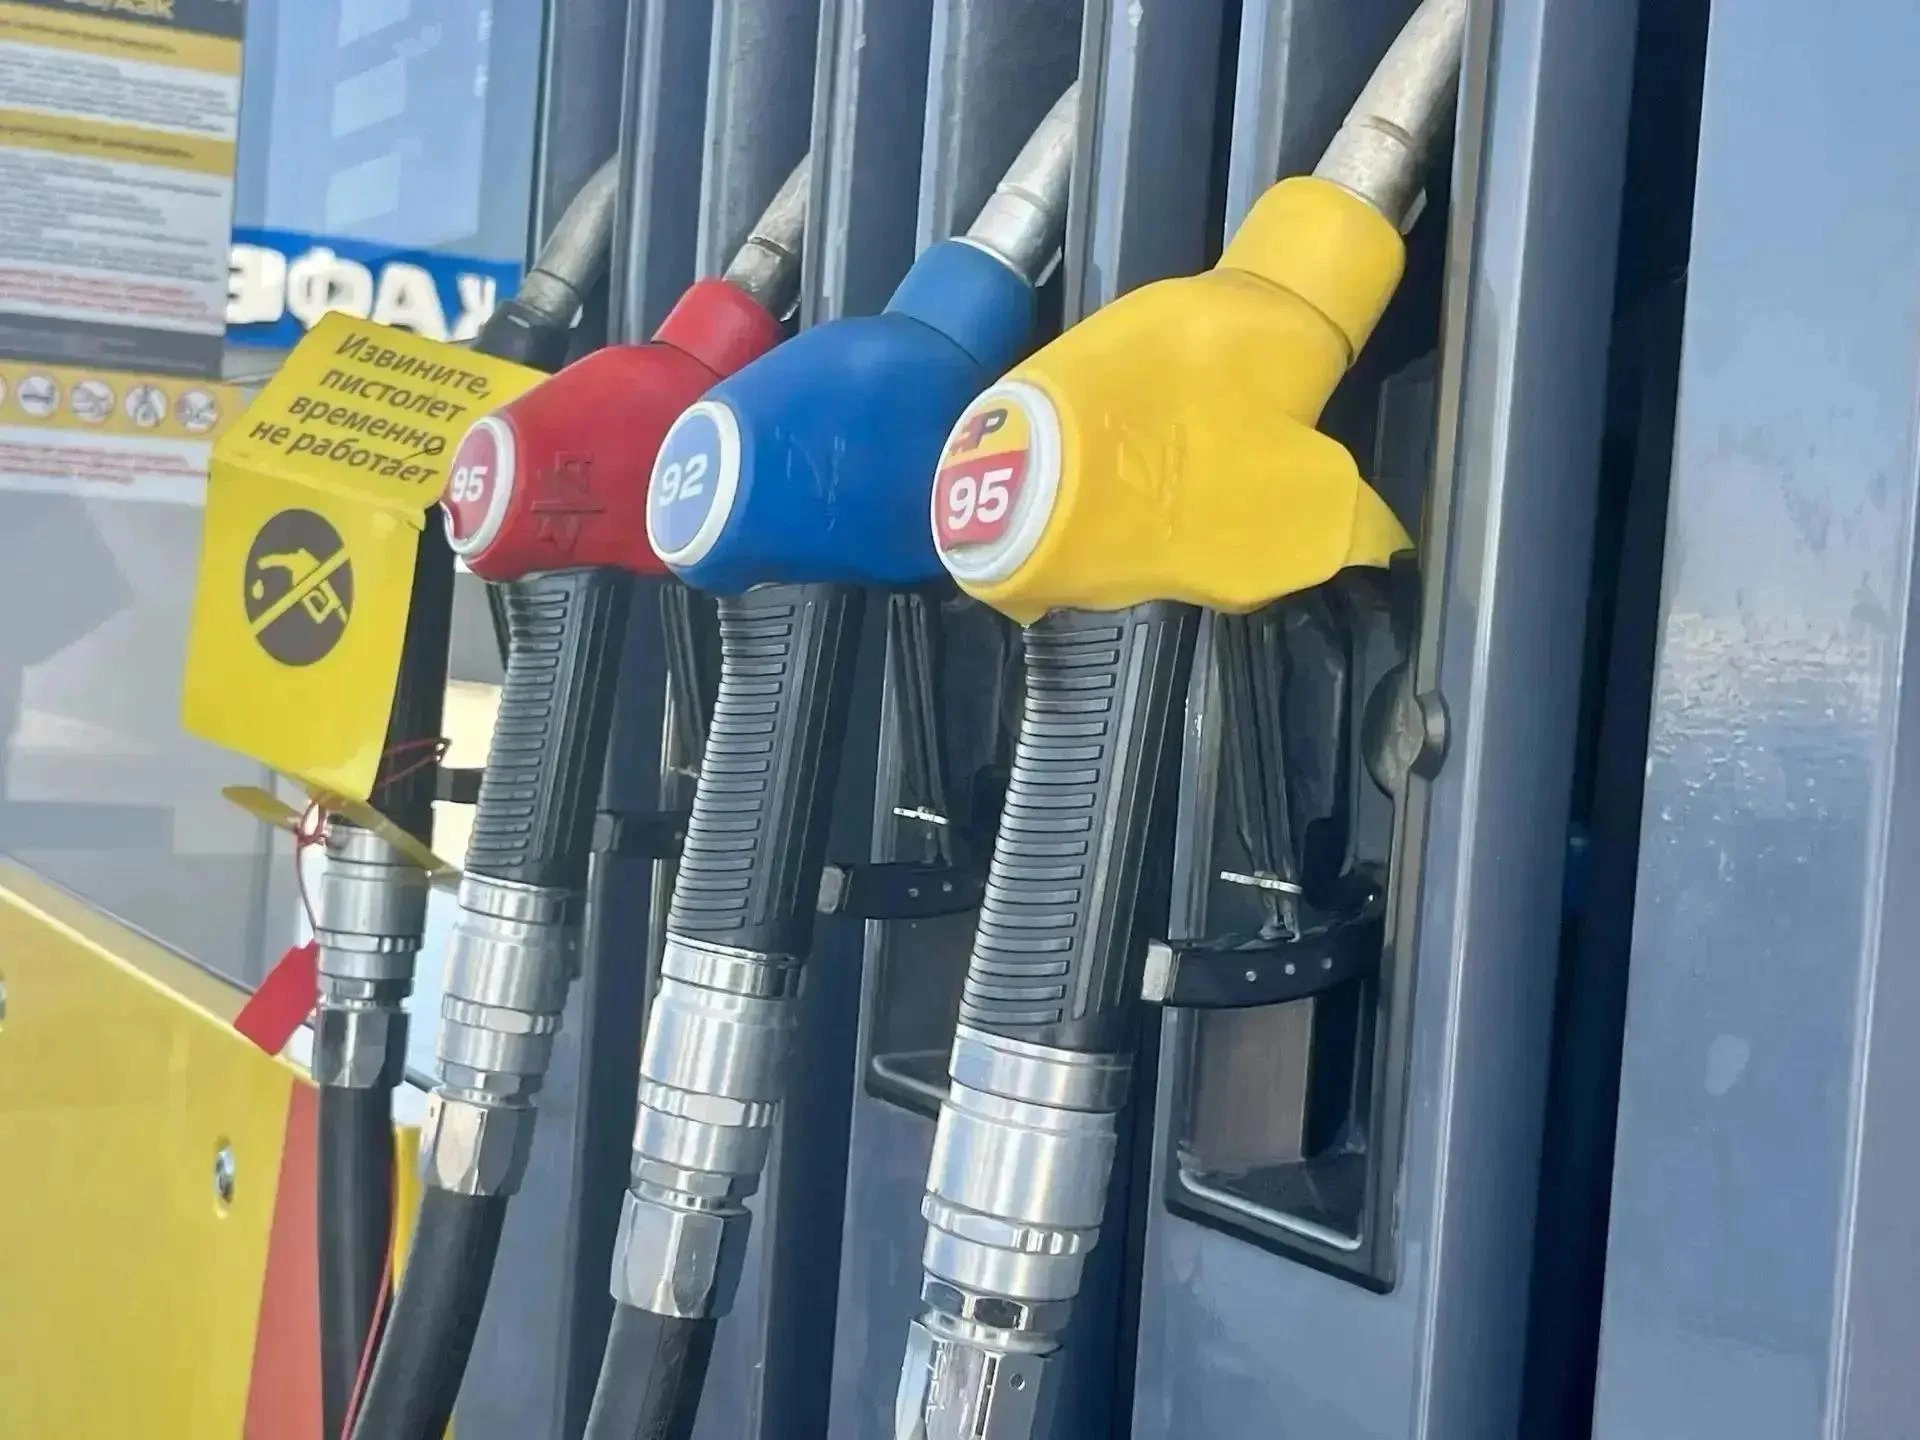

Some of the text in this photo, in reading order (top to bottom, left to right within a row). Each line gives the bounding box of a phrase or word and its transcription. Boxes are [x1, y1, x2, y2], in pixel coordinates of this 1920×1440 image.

[319, 368, 466, 424] пистолет
[336, 333, 493, 400] Извините,
[249, 420, 440, 485] не работает
[288, 396, 448, 456] временно
[452, 466, 488, 502] 95
[659, 453, 708, 506] 92
[948, 467, 1013, 531] 95
